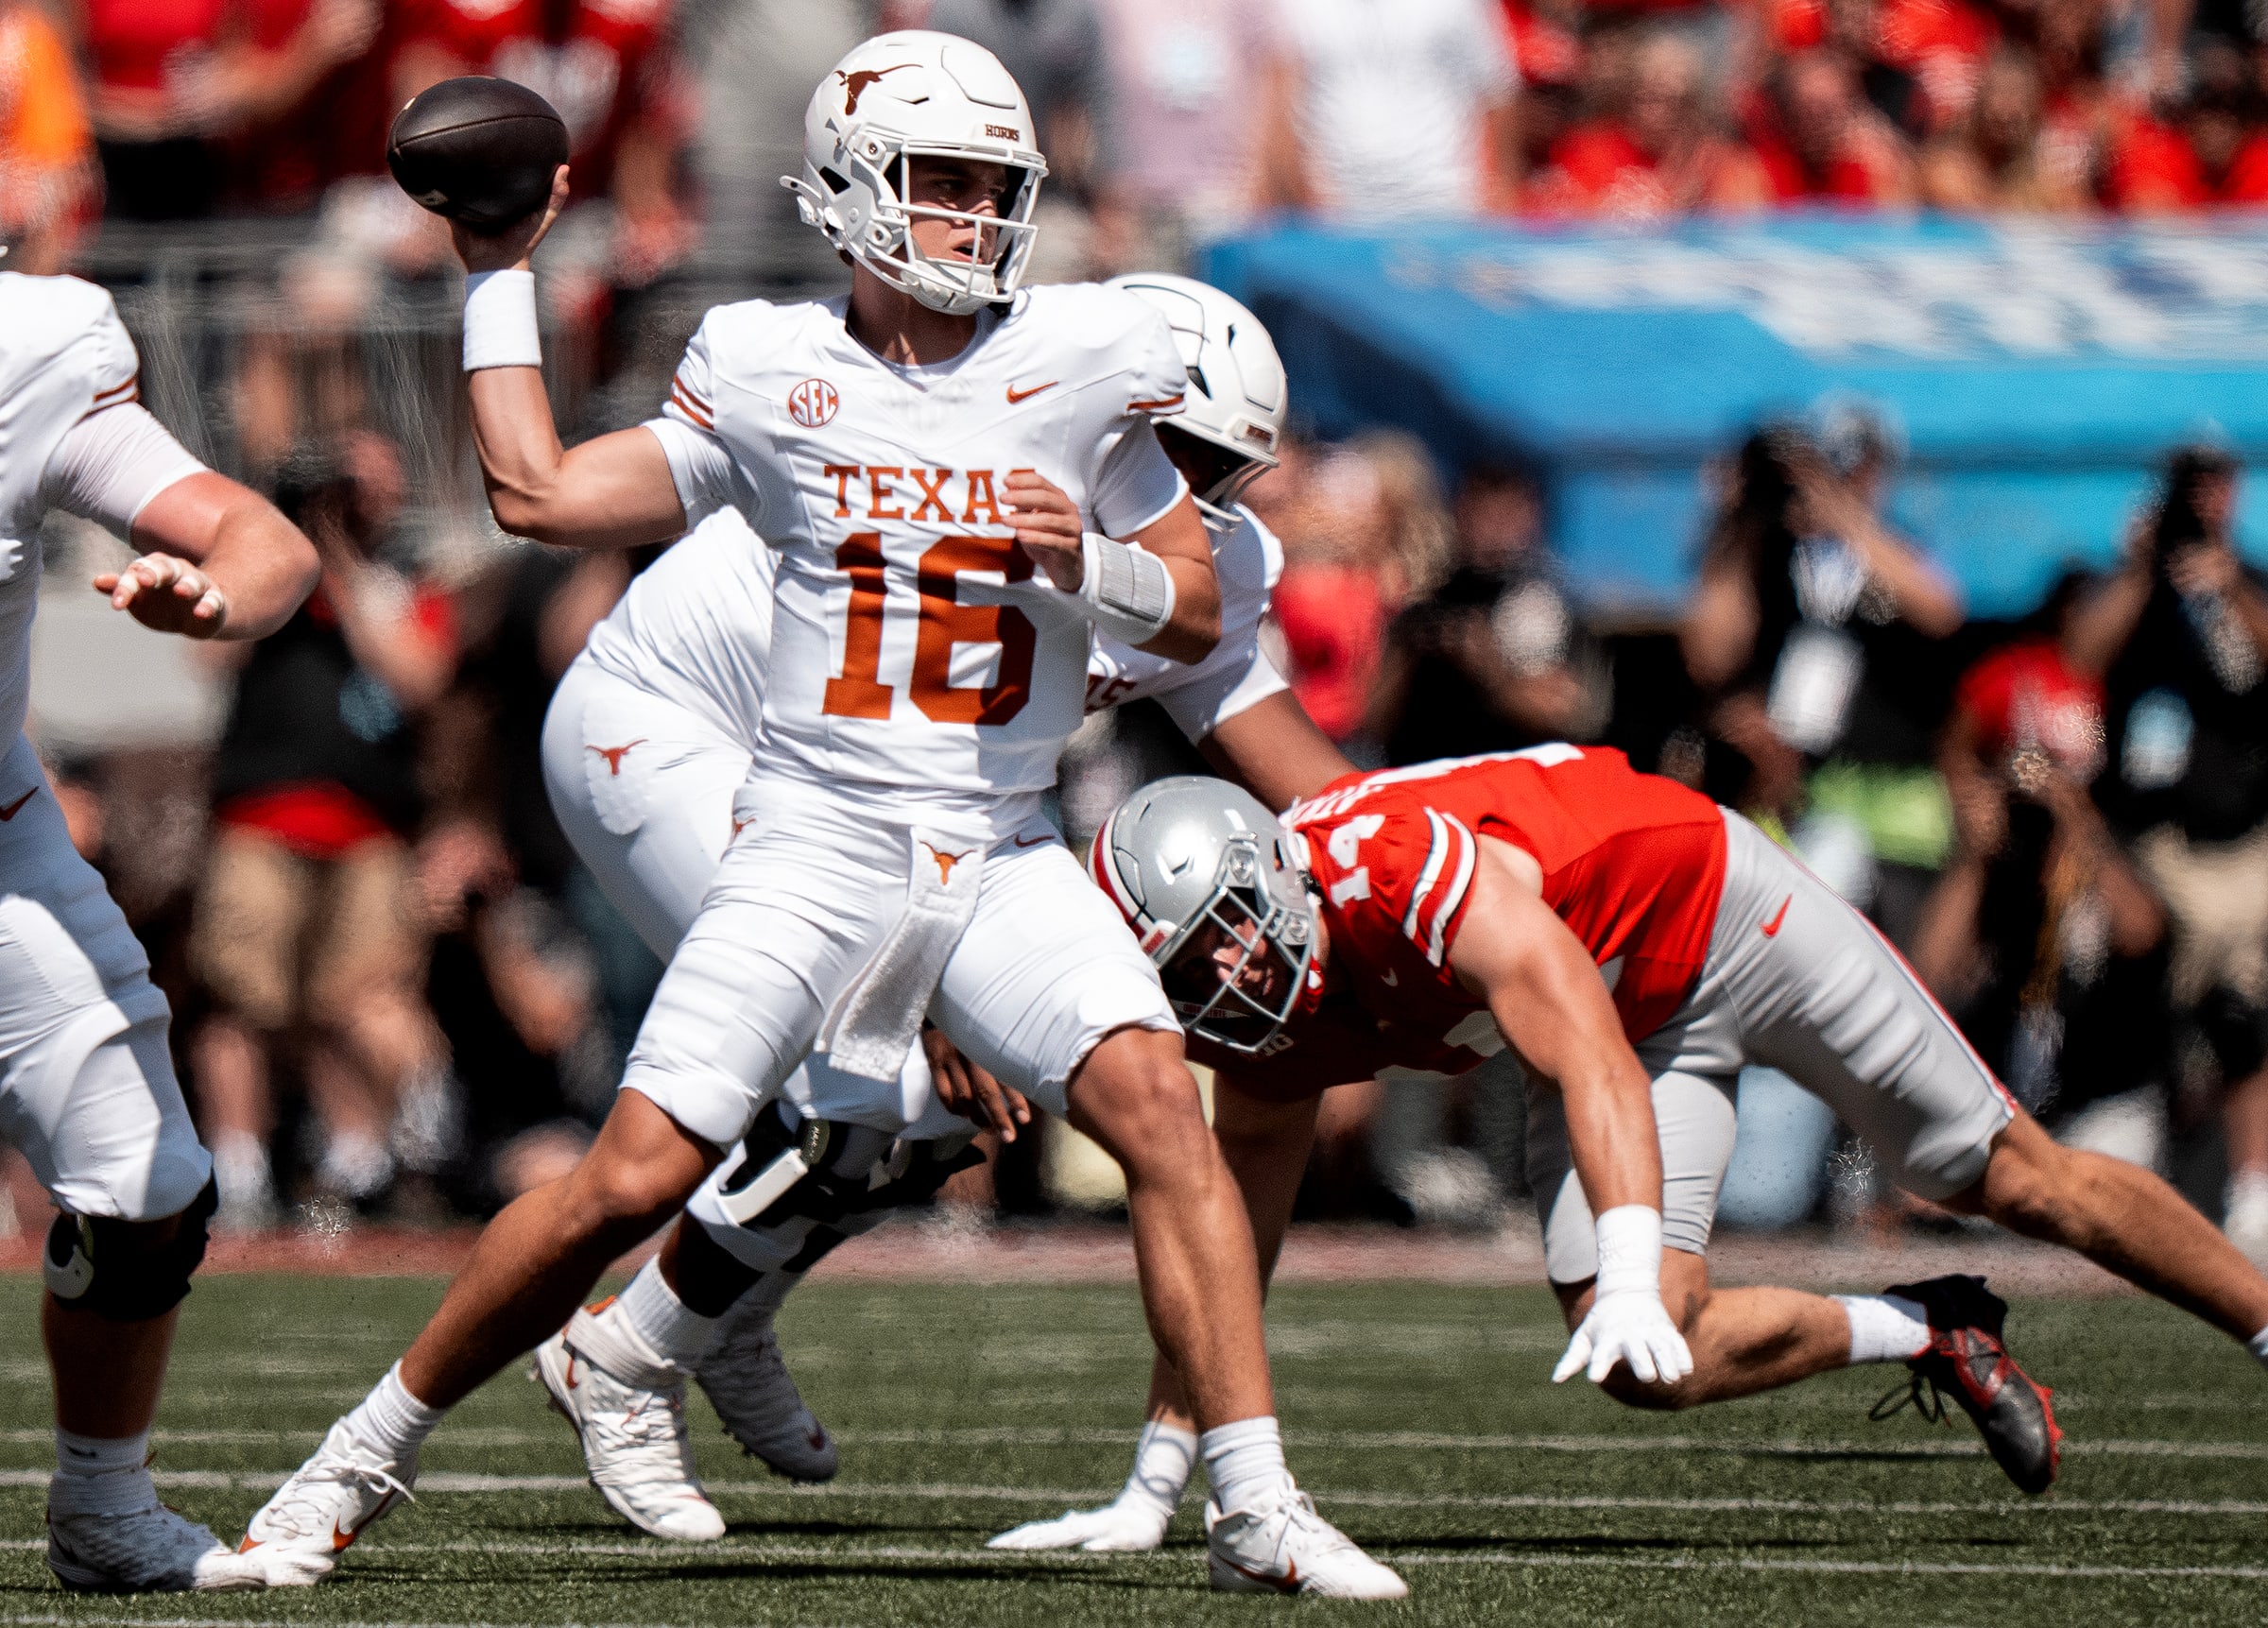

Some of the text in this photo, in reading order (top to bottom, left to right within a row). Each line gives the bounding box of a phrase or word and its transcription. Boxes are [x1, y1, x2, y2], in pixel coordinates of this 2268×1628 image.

[985, 124, 1021, 143] HORNS
[790, 380, 837, 426] SEC
[822, 531, 1037, 726] 16
